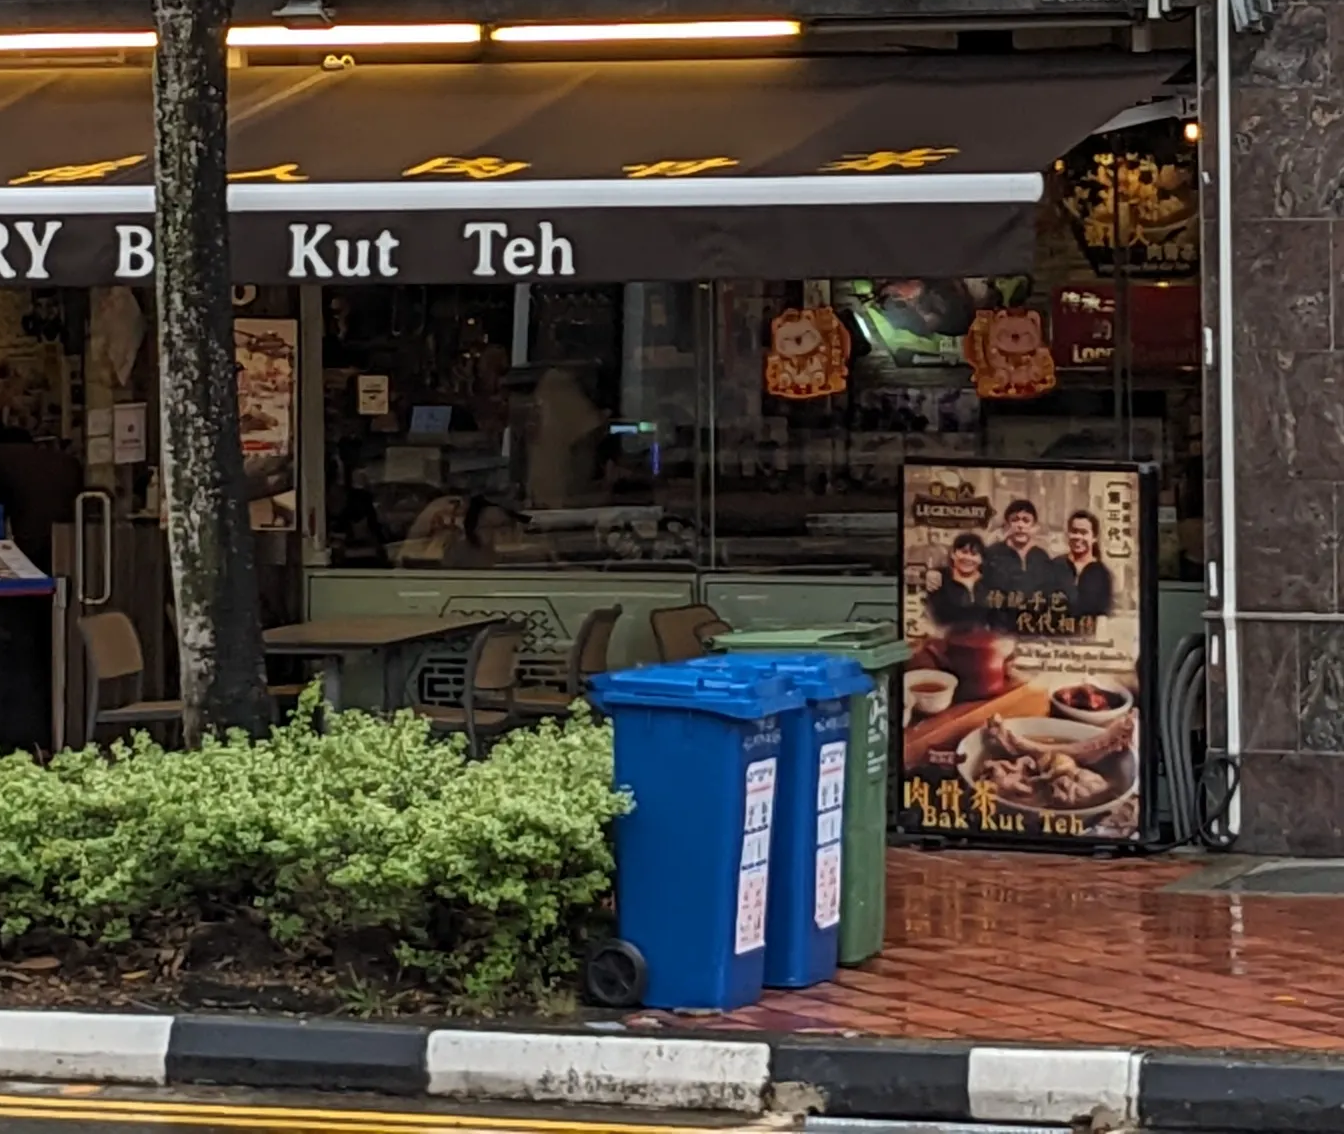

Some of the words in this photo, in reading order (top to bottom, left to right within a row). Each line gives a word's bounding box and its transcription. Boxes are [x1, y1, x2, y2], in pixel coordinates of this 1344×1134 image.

[288, 222, 400, 278] Kut
[464, 221, 576, 276] Teh
[903, 776, 998, 814] 肉骨茶
[922, 805, 969, 830] Bak
[1040, 810, 1086, 836] Teh
